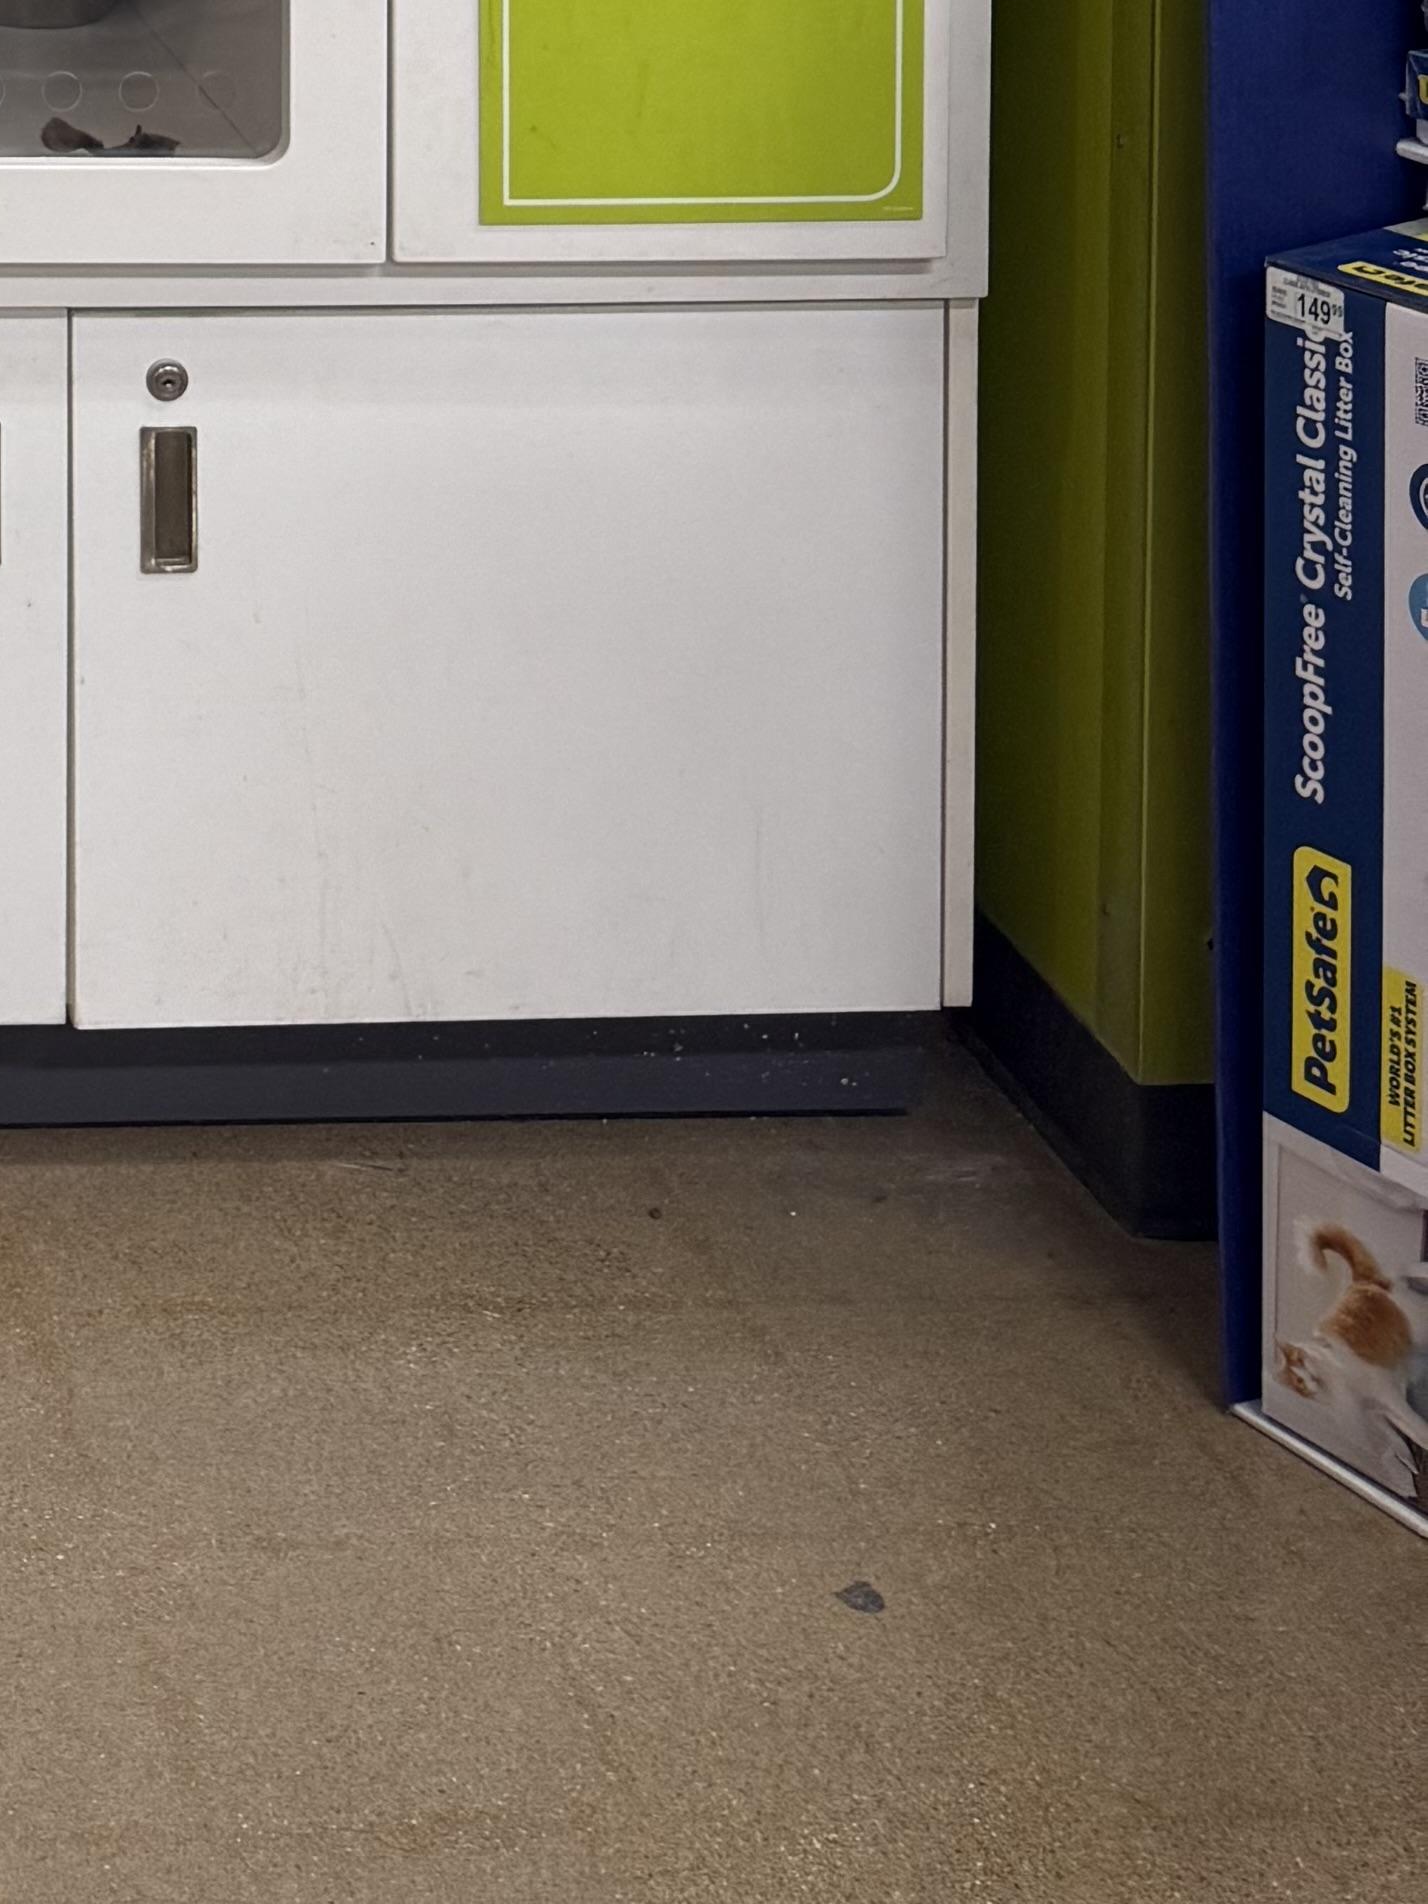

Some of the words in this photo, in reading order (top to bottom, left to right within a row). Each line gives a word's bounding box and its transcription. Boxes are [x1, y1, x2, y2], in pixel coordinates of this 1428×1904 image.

[1297, 293, 1331, 325] 149
[1334, 331, 1353, 375] Box
[1295, 330, 1326, 449] Classi
[1334, 376, 1353, 441] Litter
[1295, 453, 1334, 590] Crystal
[1334, 444, 1358, 601] Self-Cleaning
[1303, 911, 1339, 1097] PetSafe
[1389, 1004, 1403, 1029] #1
[1403, 980, 1417, 1050] SYSTEM
[1387, 1030, 1403, 1107] WORLD'S
[1403, 1051, 1417, 1087] BOX
[1402, 1091, 1417, 1148] LITTER
